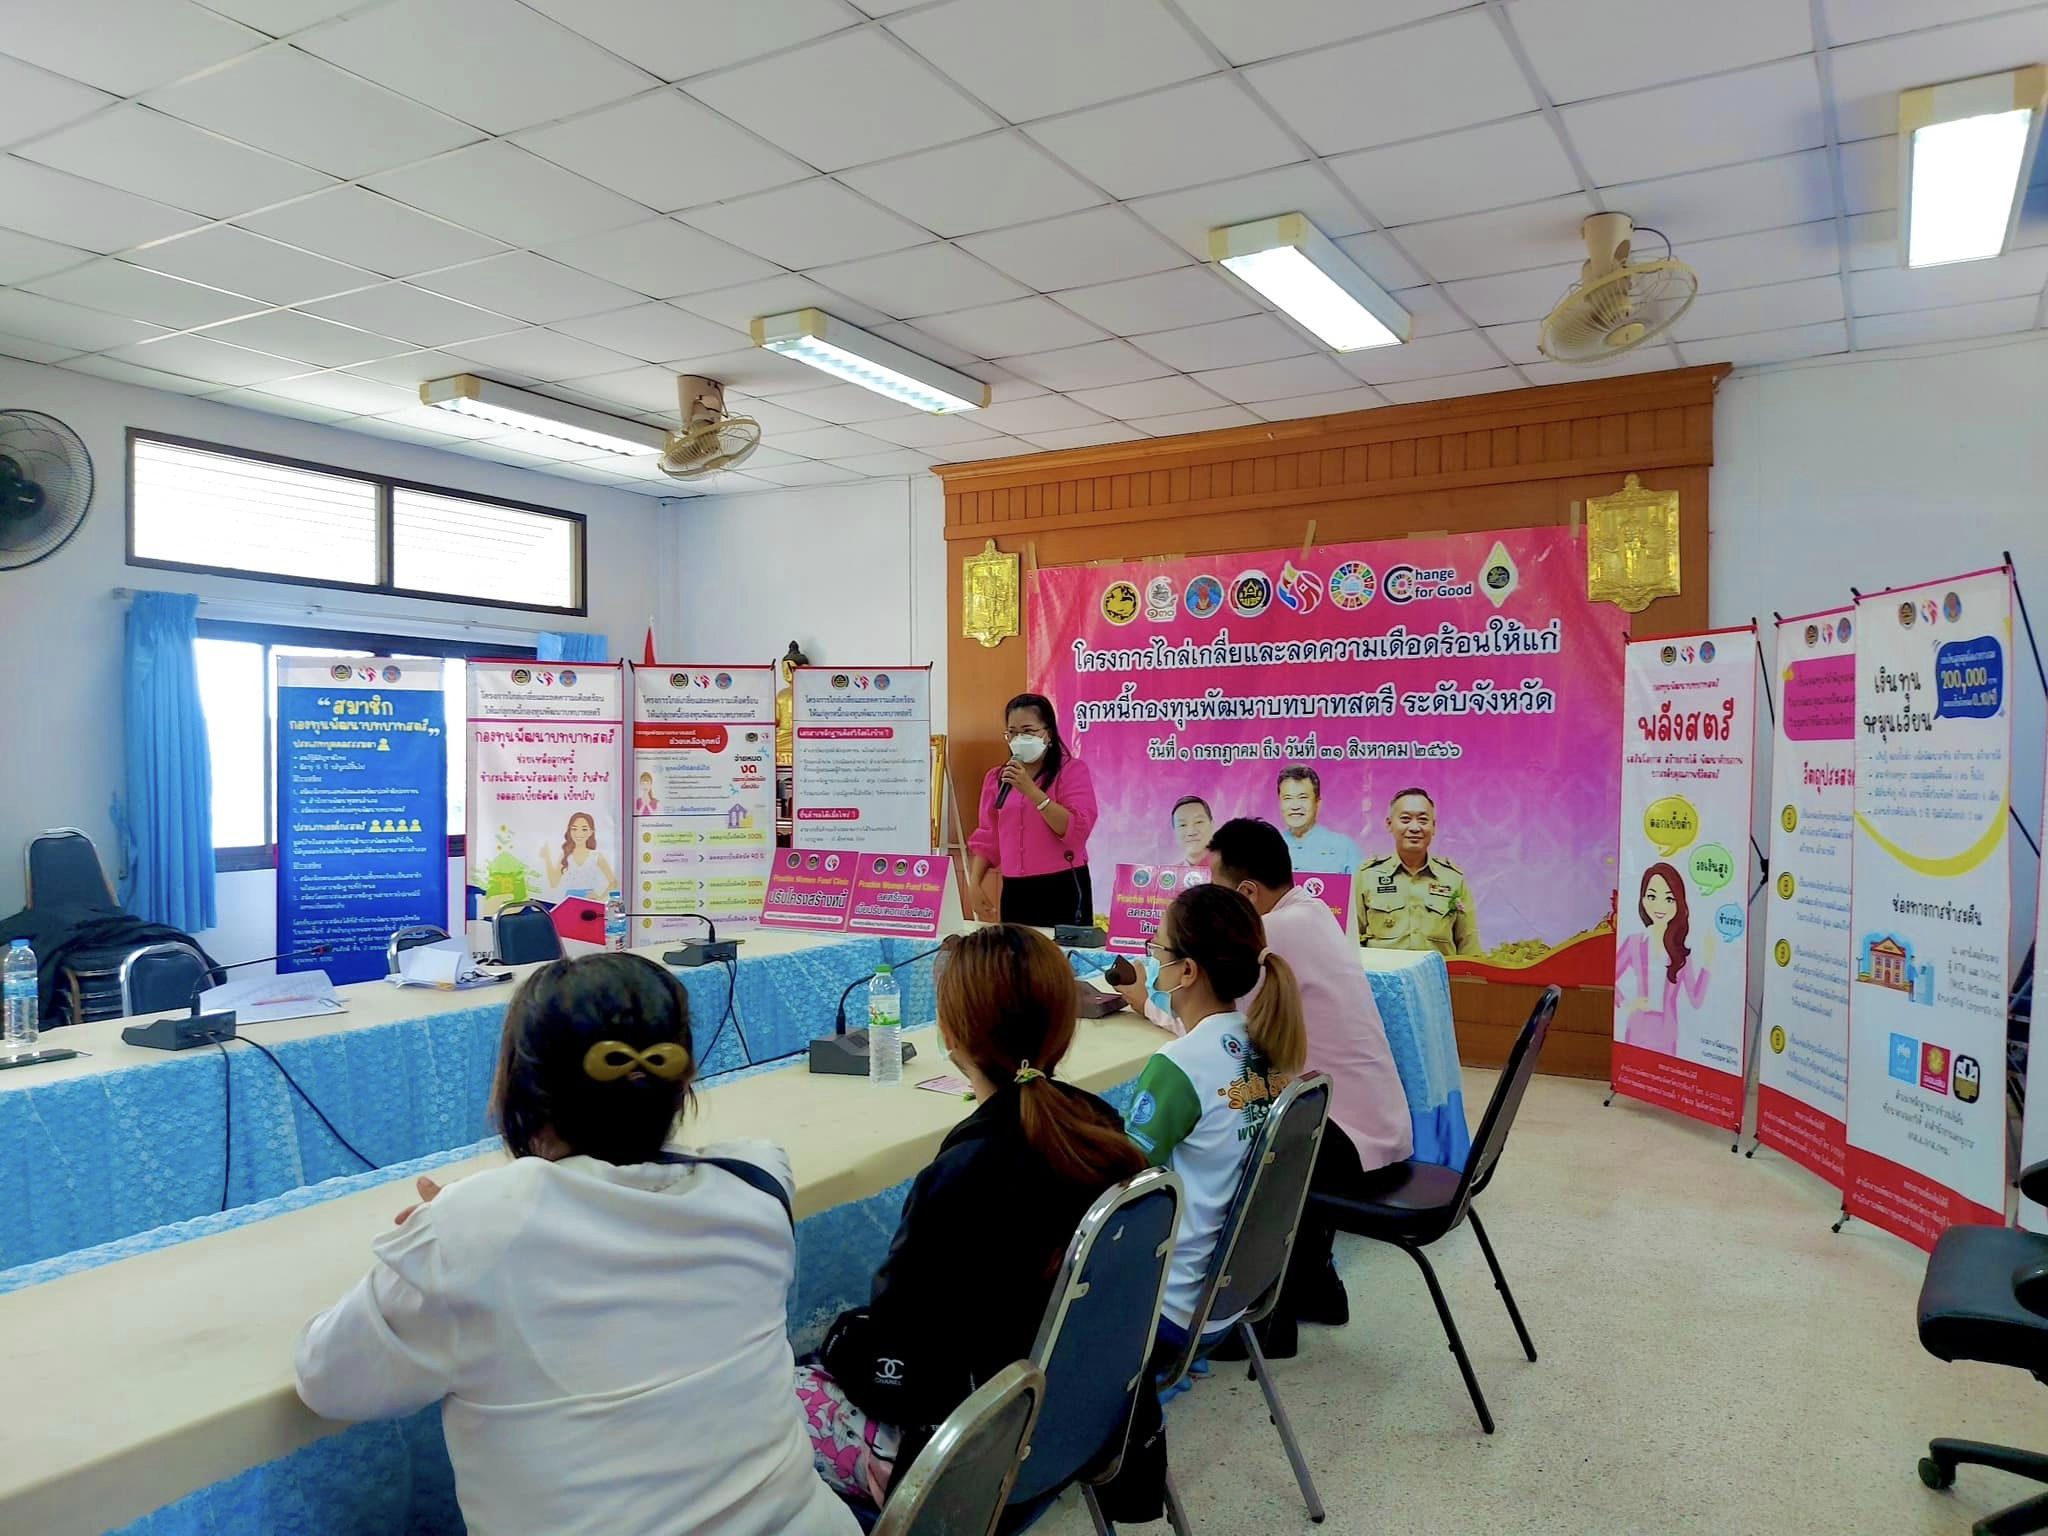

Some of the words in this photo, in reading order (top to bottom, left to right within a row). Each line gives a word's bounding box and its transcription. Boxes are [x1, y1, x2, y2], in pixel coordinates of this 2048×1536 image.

[1415, 587, 1433, 598] for
[1438, 584, 1472, 597] Good
[1076, 621, 1557, 669] โครงการไกล่เกลี่ยและลดความเดือดร้อนให้แก่
[1874, 666, 1921, 702] เงินทุน
[481, 690, 604, 702] โครงการไกล่เกลี่ยและลดความเดือดร้อน
[1077, 685, 1394, 730] ลูกหนี้กองทุนพัฒนาบทบาทสตรี
[1404, 681, 1553, 713] ระดับจังหวัด
[1638, 698, 1734, 741] พลังสตรี
[1863, 704, 1933, 744] หมุนเวียน
[475, 728, 615, 748] กองทุนพัฒนาบทบาทสตรี
[1149, 736, 1177, 758] วันที่
[1181, 749, 1189, 760] ๑
[1195, 743, 1258, 763] กรกฎาคม
[1264, 738, 1281, 757] ถึง
[1286, 734, 1315, 757] วันที่
[1322, 748, 1342, 759] ๓๑
[1349, 738, 1407, 757] สิงหาคม
[1414, 743, 1461, 757] ๒๕๖๖
[517, 750, 575, 768] ช่วยเหลือลูกหนี้
[480, 768, 578, 782] ชำระเงินต้นพร้อมดอกเบี้ย
[741, 764, 757, 774] งด
[564, 786, 595, 800] เบี้ยปรับ
[1650, 811, 1691, 830] ดอกเบี้ยต่ำ
[1696, 858, 1728, 878] วงเงินสูง
[769, 888, 847, 907] ปรับโครงสร้างหนี้
[875, 1378, 902, 1386] CHANEL
